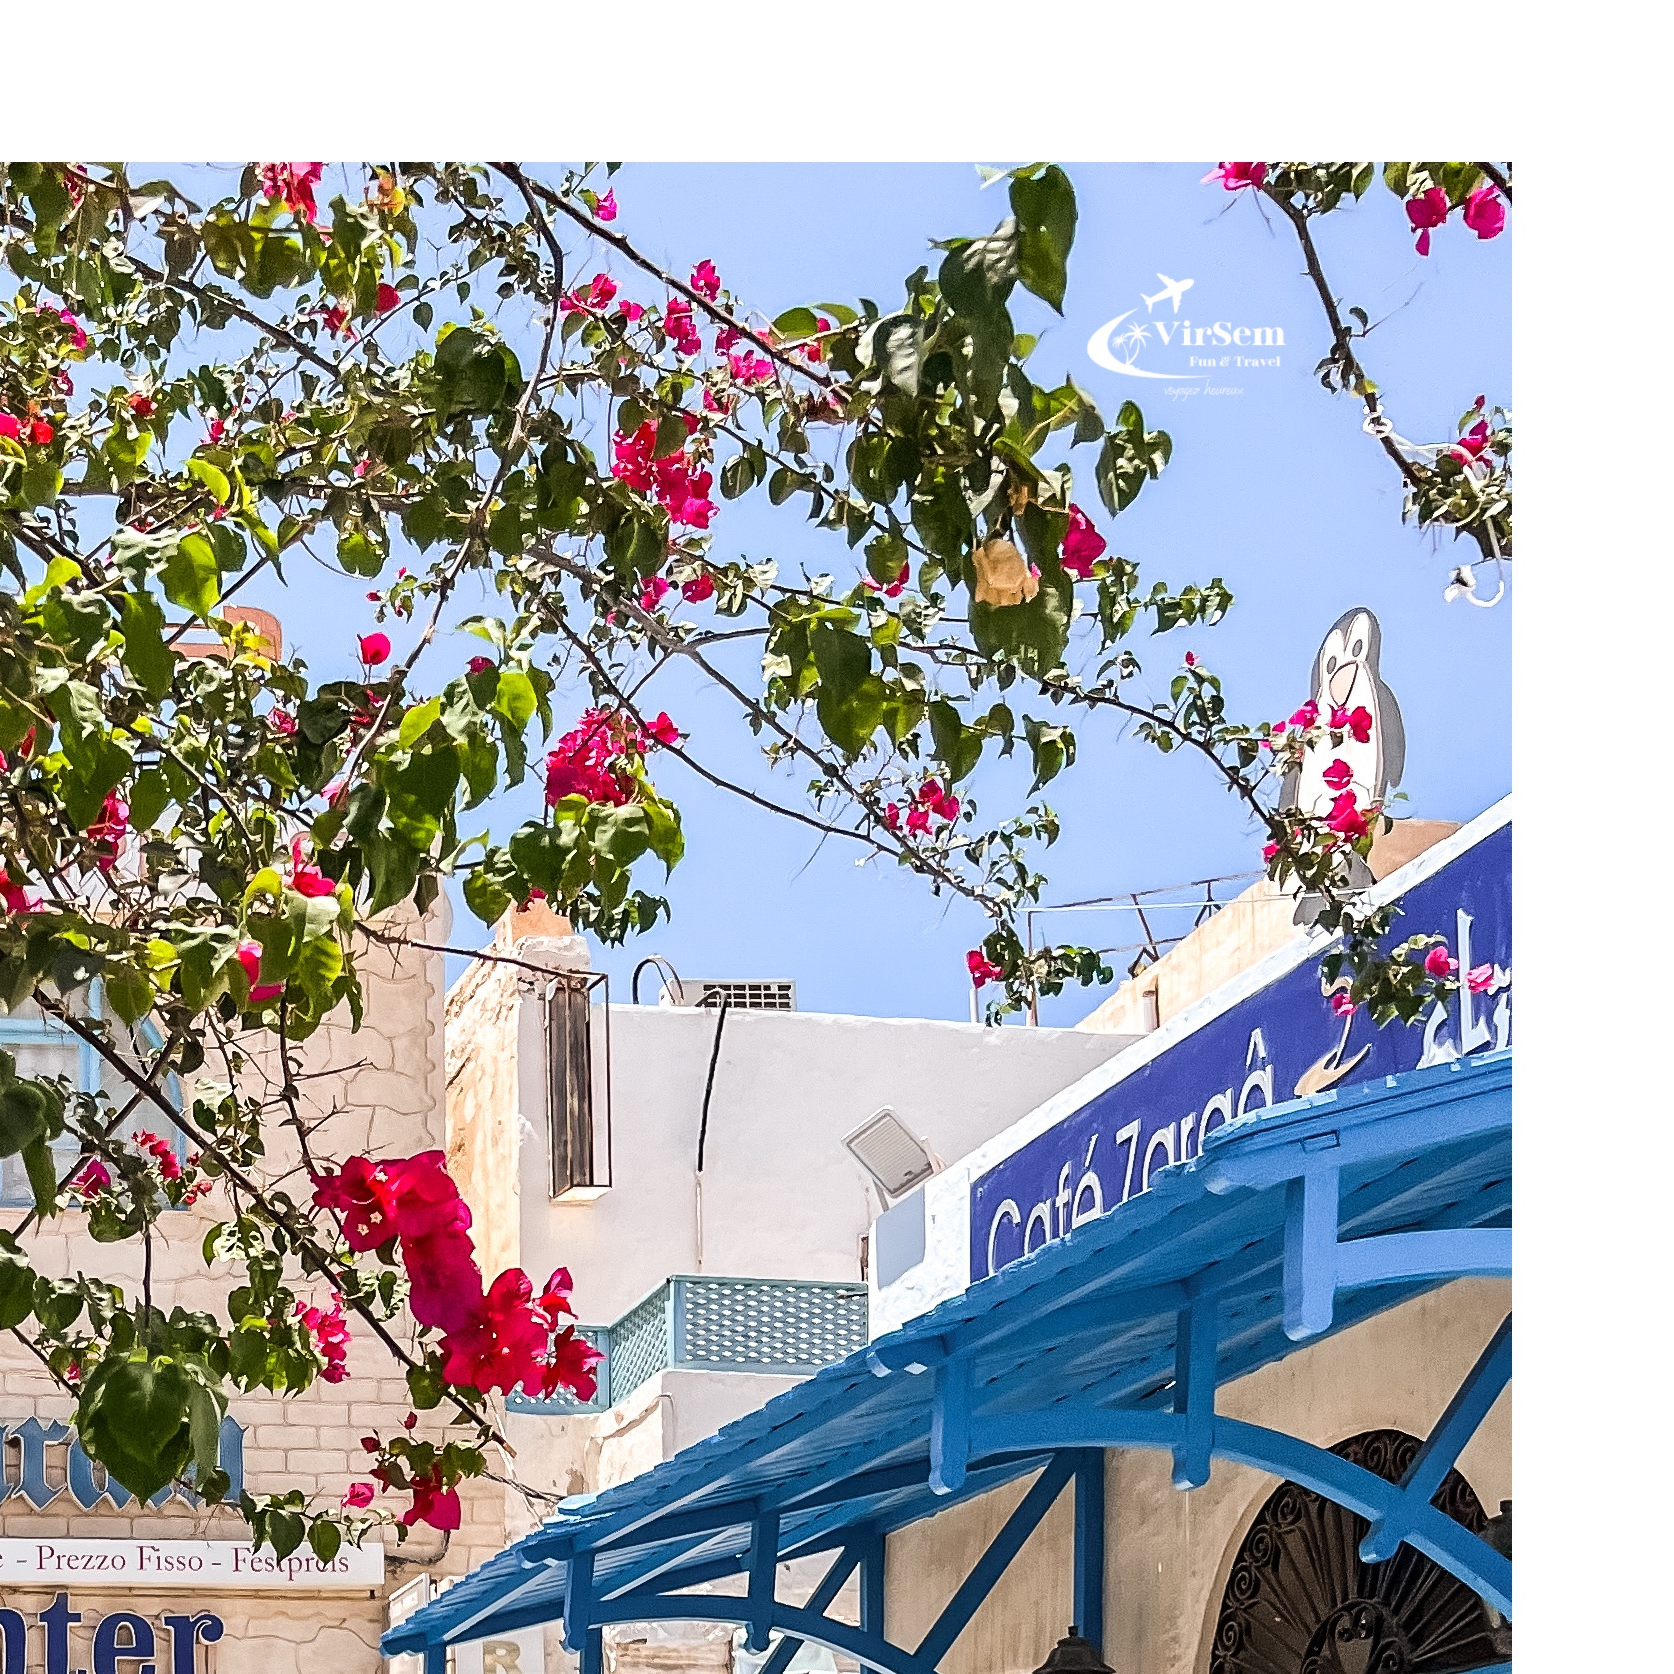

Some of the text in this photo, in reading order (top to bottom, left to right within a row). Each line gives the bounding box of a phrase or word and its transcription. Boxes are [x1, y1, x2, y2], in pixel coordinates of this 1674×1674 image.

[987, 1133, 1104, 1278] Café
[36, 1545, 126, 1572] Prezzo
[135, 1545, 204, 1572] Fisso
